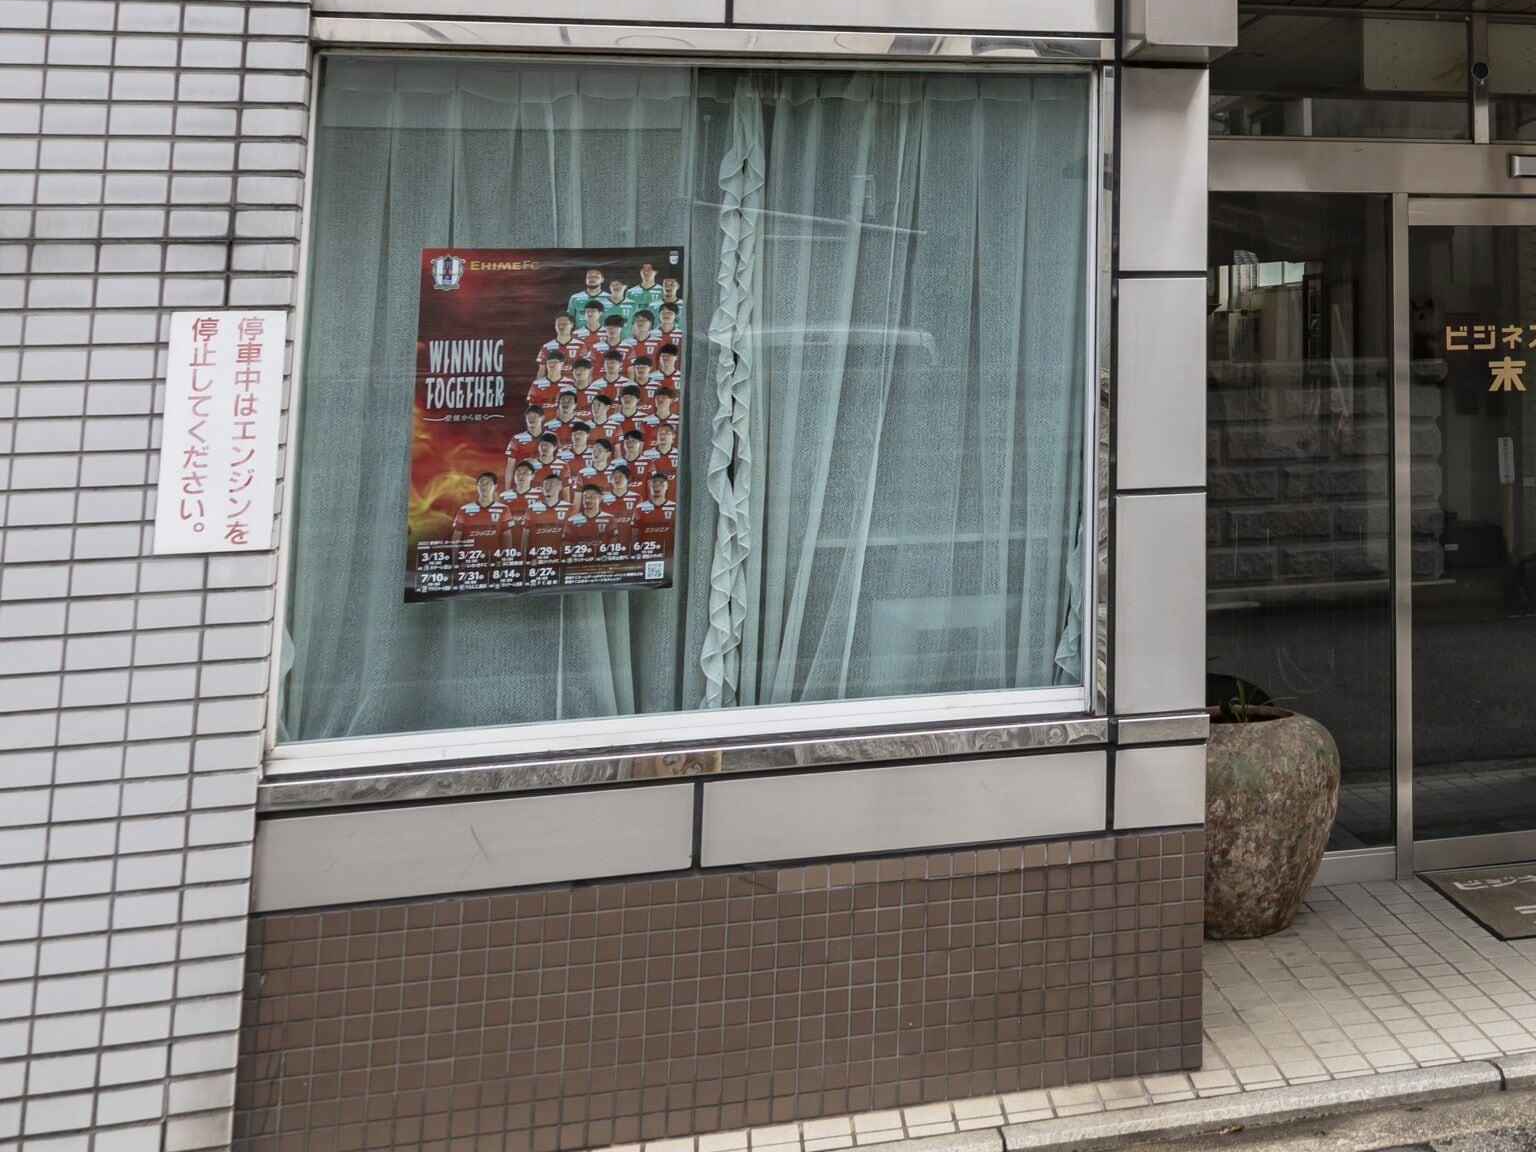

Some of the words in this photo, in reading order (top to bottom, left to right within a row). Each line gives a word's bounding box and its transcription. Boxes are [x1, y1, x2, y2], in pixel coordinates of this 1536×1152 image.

[470, 260, 521, 271] EHIME
[429, 339, 504, 373] WINNING
[425, 376, 505, 410] TOGETHER
[179, 317, 220, 533] 停止してください。
[224, 316, 265, 545] 停車中はエンジンを
[564, 544, 587, 554] 5/29
[599, 543, 621, 553] 6/18
[633, 541, 656, 551] 6/25
[458, 550, 482, 560] 3/27
[493, 548, 517, 558] 4/10
[529, 547, 553, 556] 4/29
[421, 552, 445, 562] 3/13
[458, 571, 480, 581] 7/31
[492, 569, 516, 579] 8/14
[528, 567, 552, 577] 8/27
[421, 573, 444, 583] 7/10
